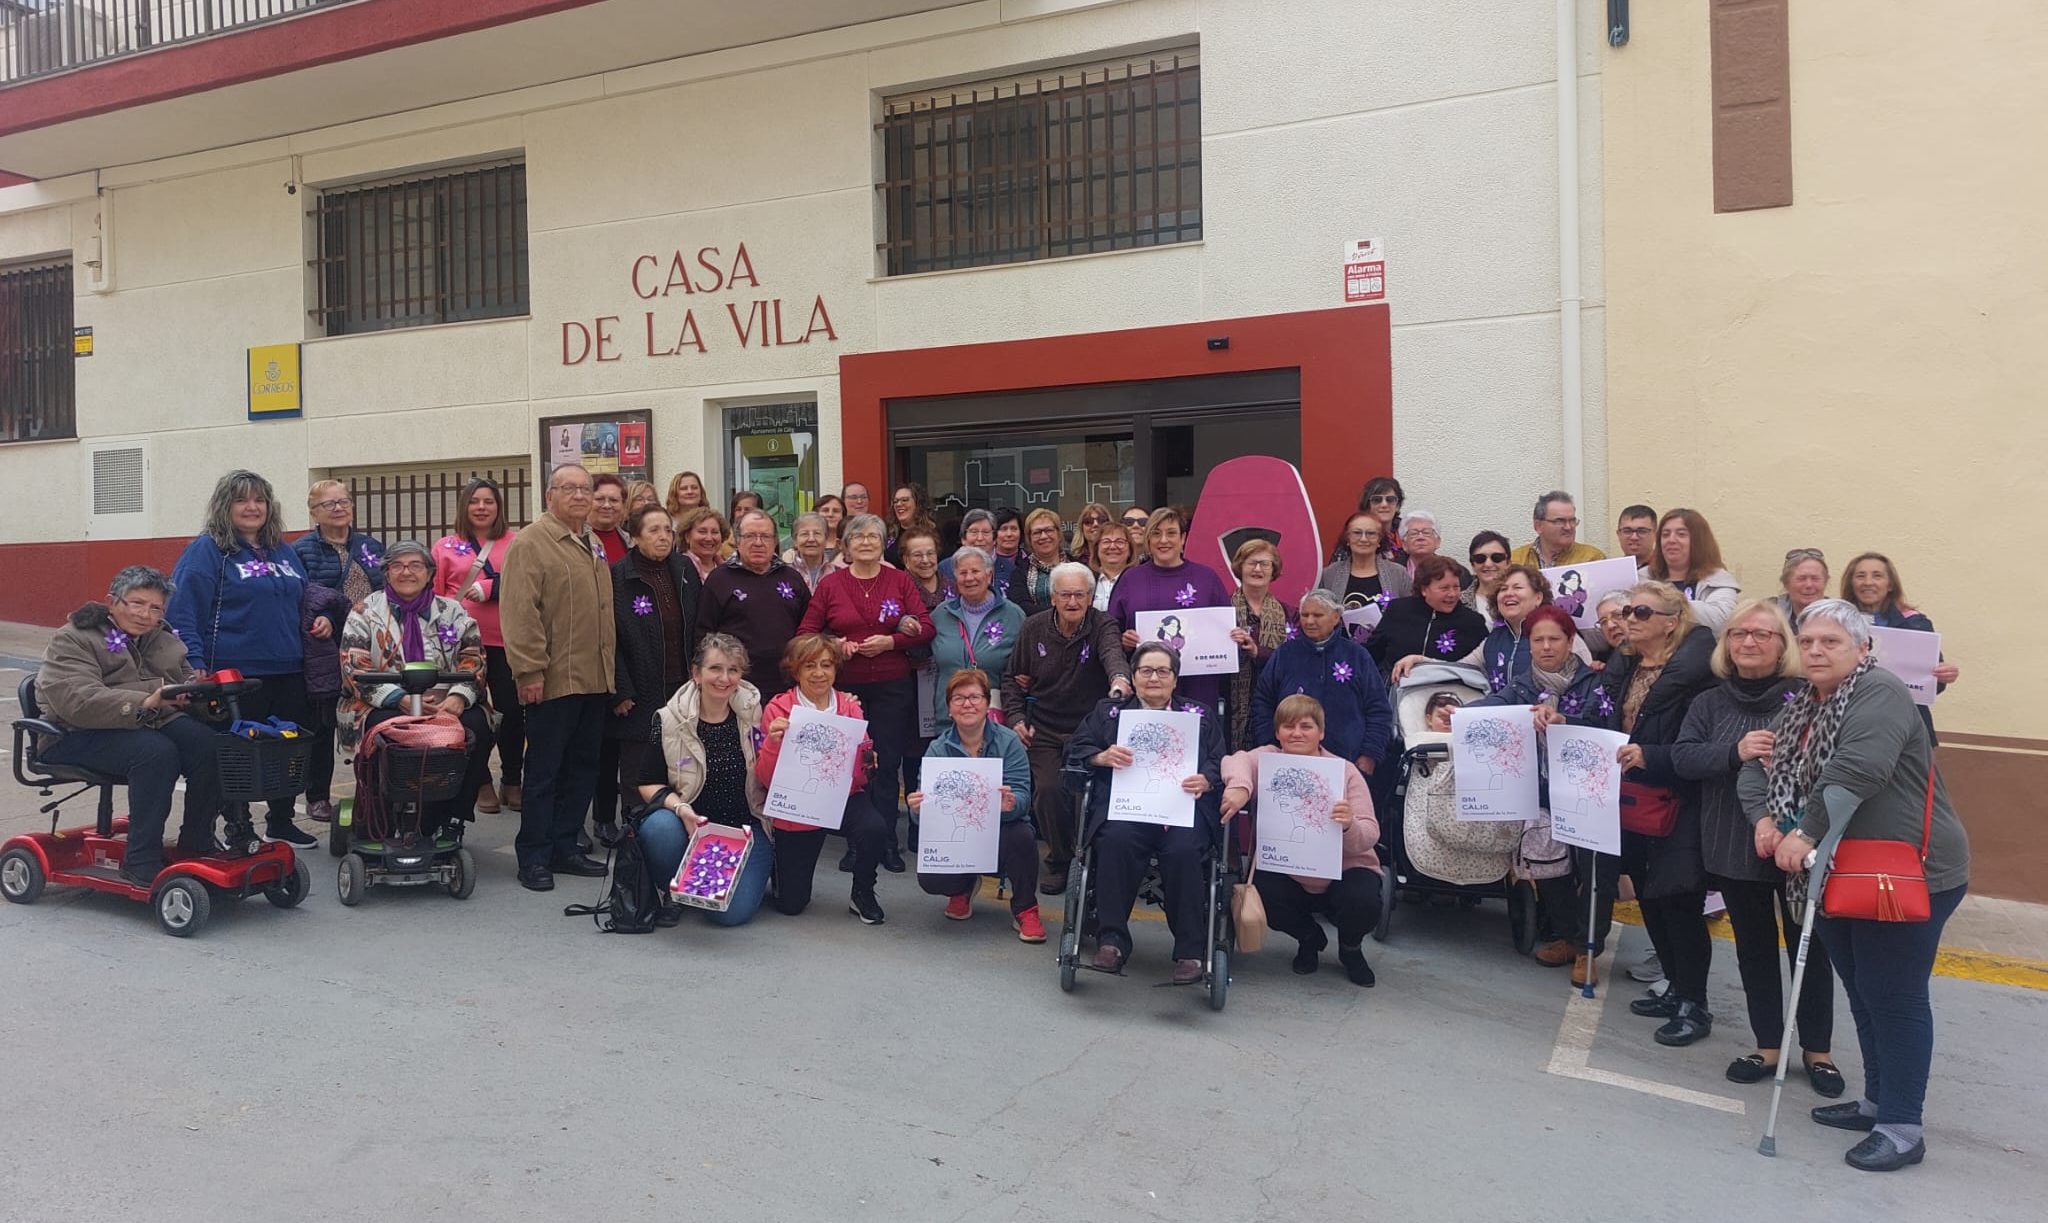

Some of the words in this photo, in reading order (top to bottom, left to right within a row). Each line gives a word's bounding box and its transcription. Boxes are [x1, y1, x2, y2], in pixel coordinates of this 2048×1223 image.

[631, 241, 760, 299] CASA
[1347, 264, 1382, 275] Alarma
[561, 315, 623, 365] DE
[646, 308, 708, 357] LA
[725, 294, 838, 348] VILA
[254, 382, 295, 394] CORREOS
